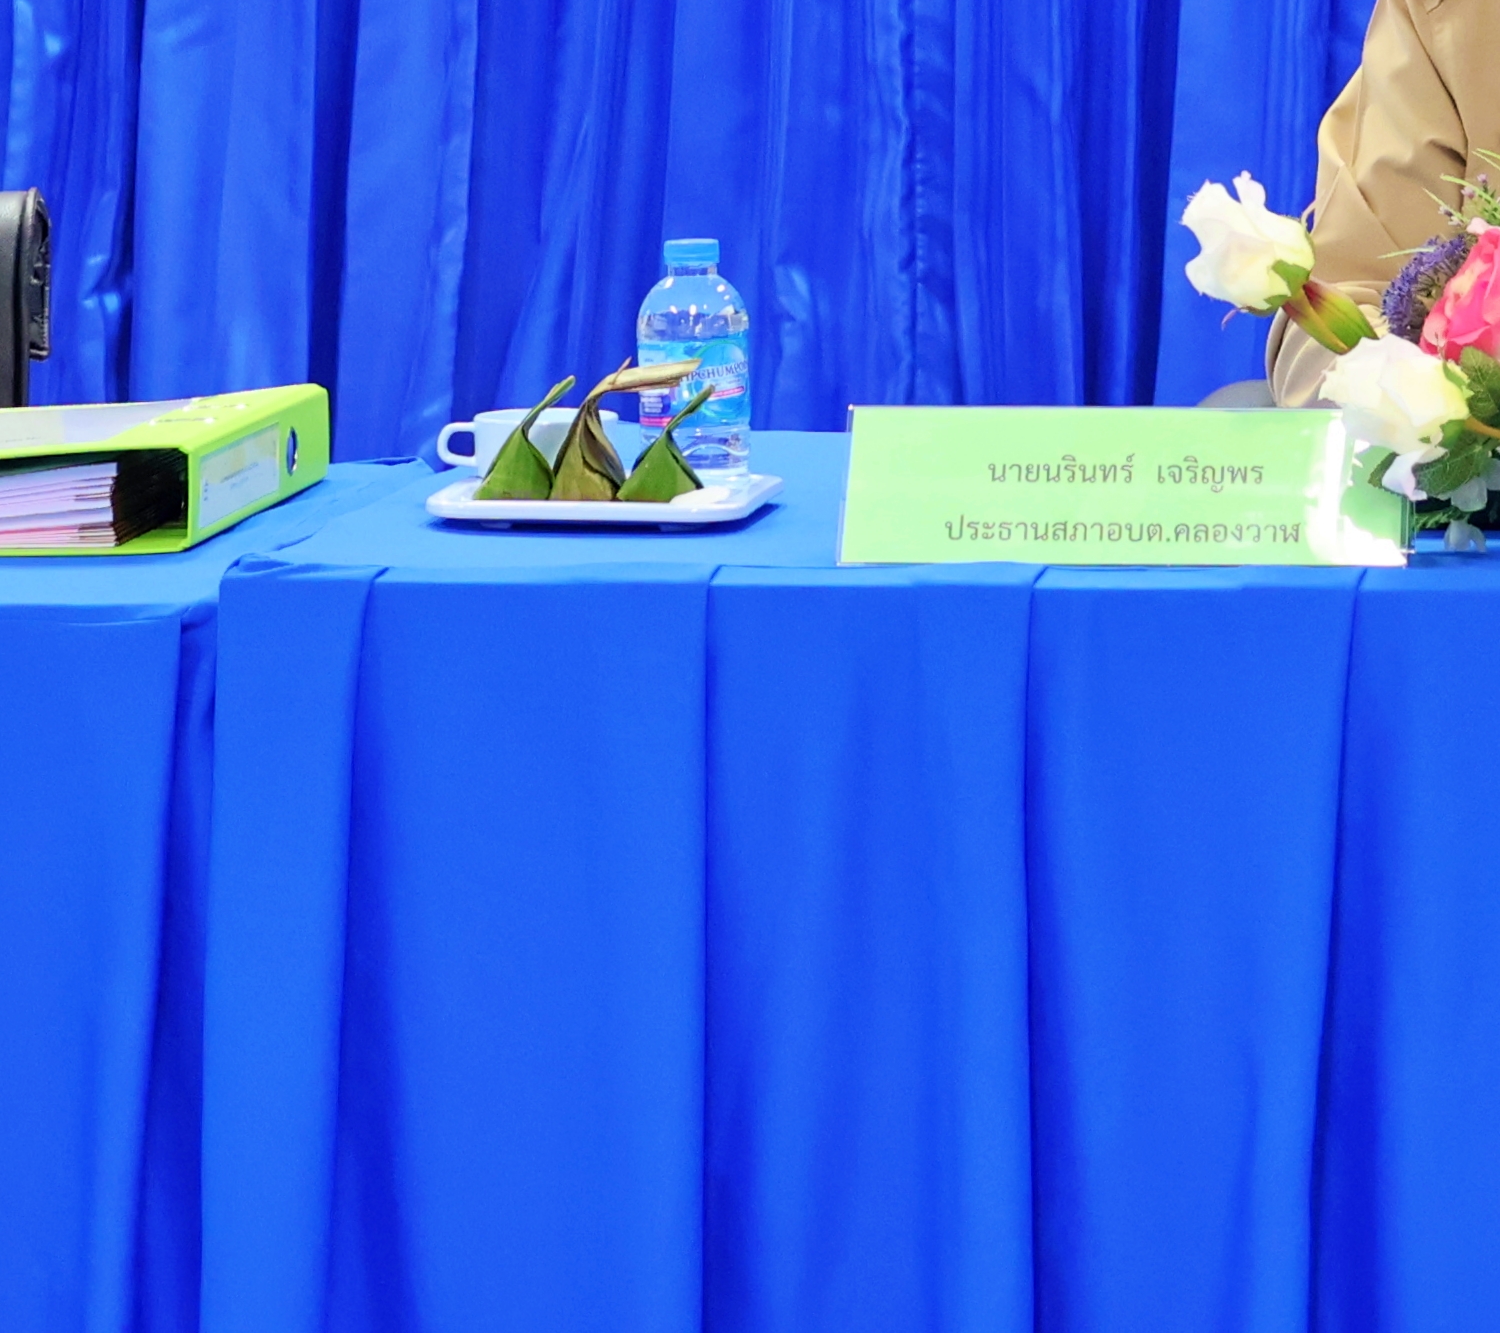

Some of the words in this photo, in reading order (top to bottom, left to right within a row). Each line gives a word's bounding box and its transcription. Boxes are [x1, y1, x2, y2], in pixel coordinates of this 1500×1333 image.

[986, 453, 1137, 486] นายนรินทร์
[1155, 453, 1266, 494] เจริญพร
[944, 515, 1301, 545] ประธานสภาอบต.คลองวาฬ
